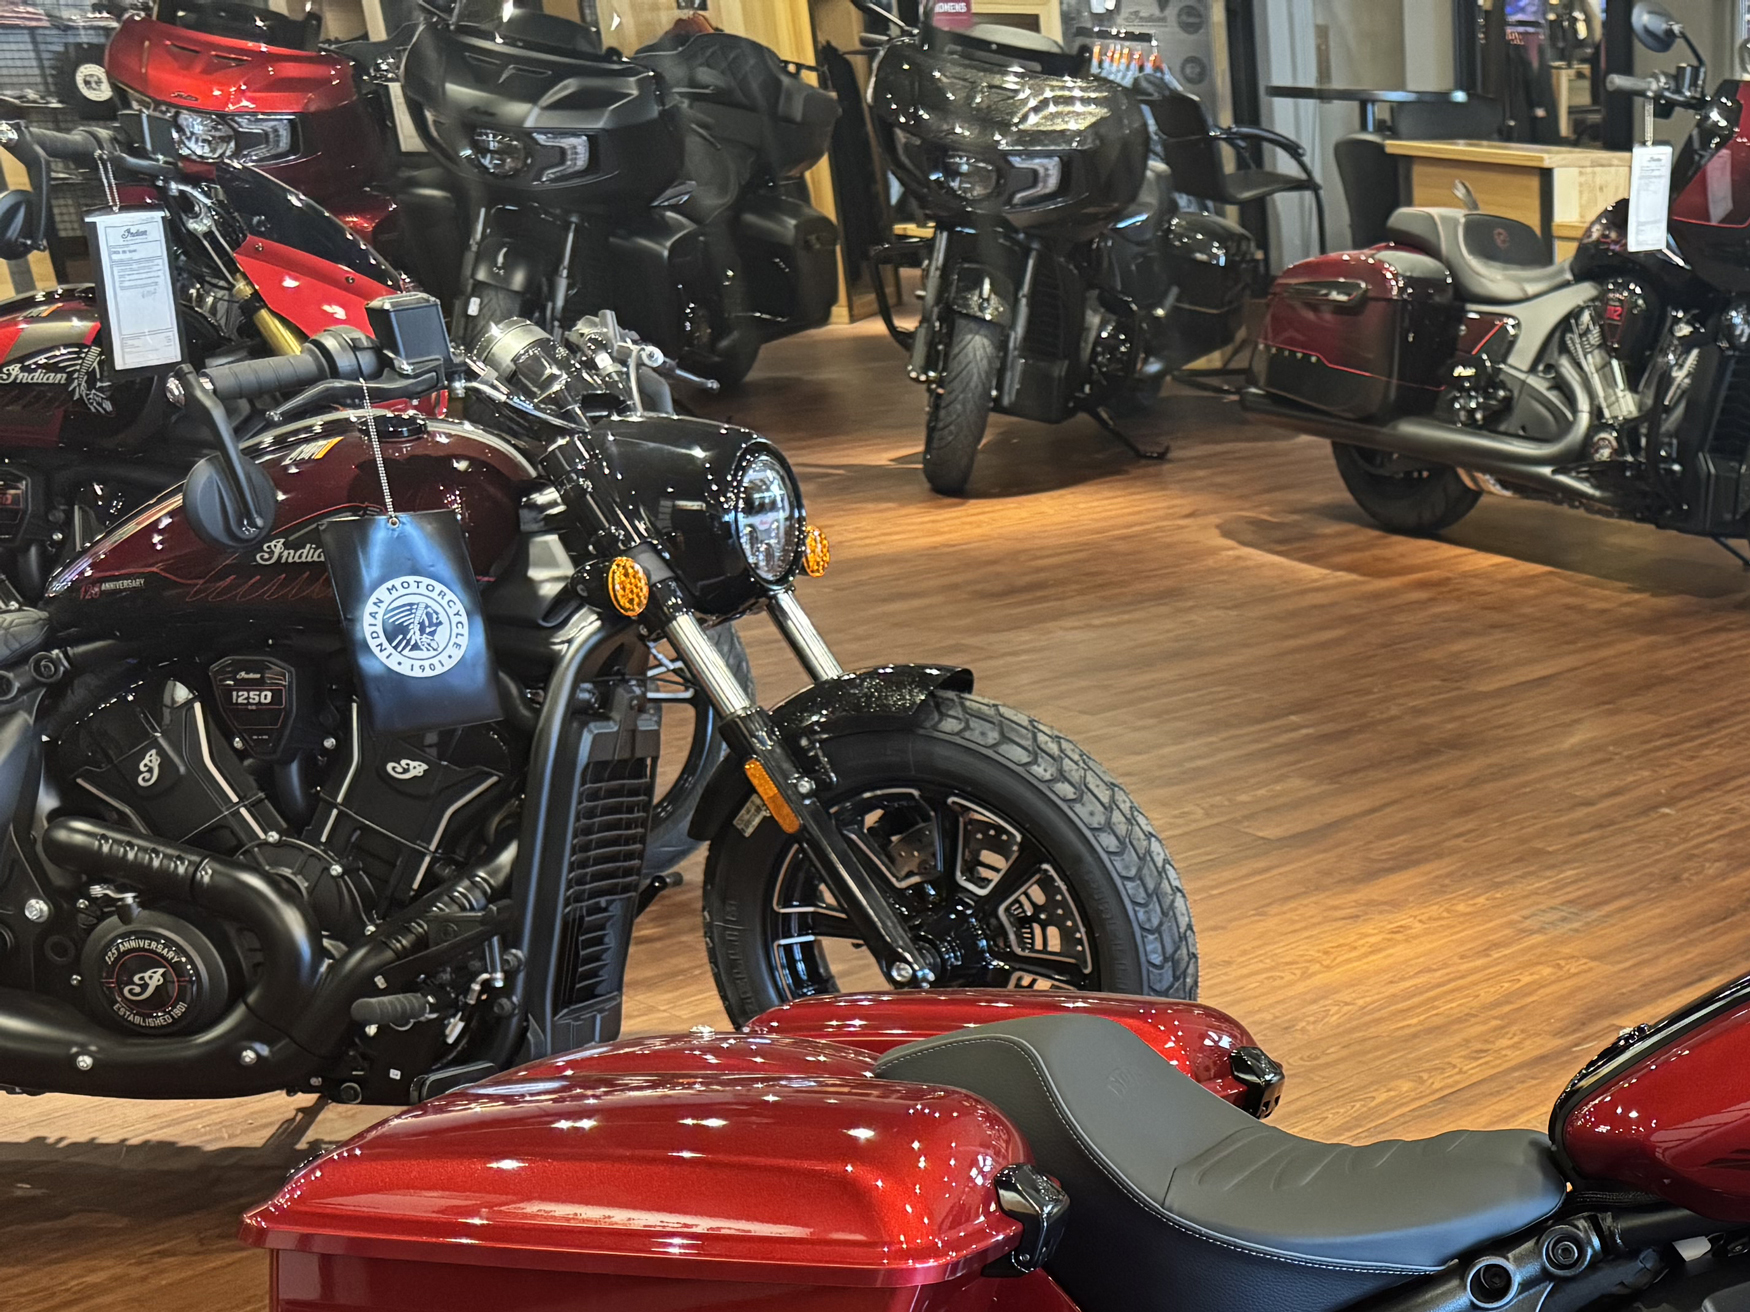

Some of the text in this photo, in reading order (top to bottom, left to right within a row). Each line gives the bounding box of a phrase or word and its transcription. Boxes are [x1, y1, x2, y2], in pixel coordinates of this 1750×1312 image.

[256, 538, 326, 566] India
[101, 578, 145, 591] ANNIVERSARY
[369, 580, 465, 660] INDIAN MOTORCYCLE
[410, 658, 445, 673] 1901
[231, 690, 273, 704] 1250
[119, 938, 181, 964] ANNIVERSARY
[112, 1002, 173, 1028] ESTABLISHED
